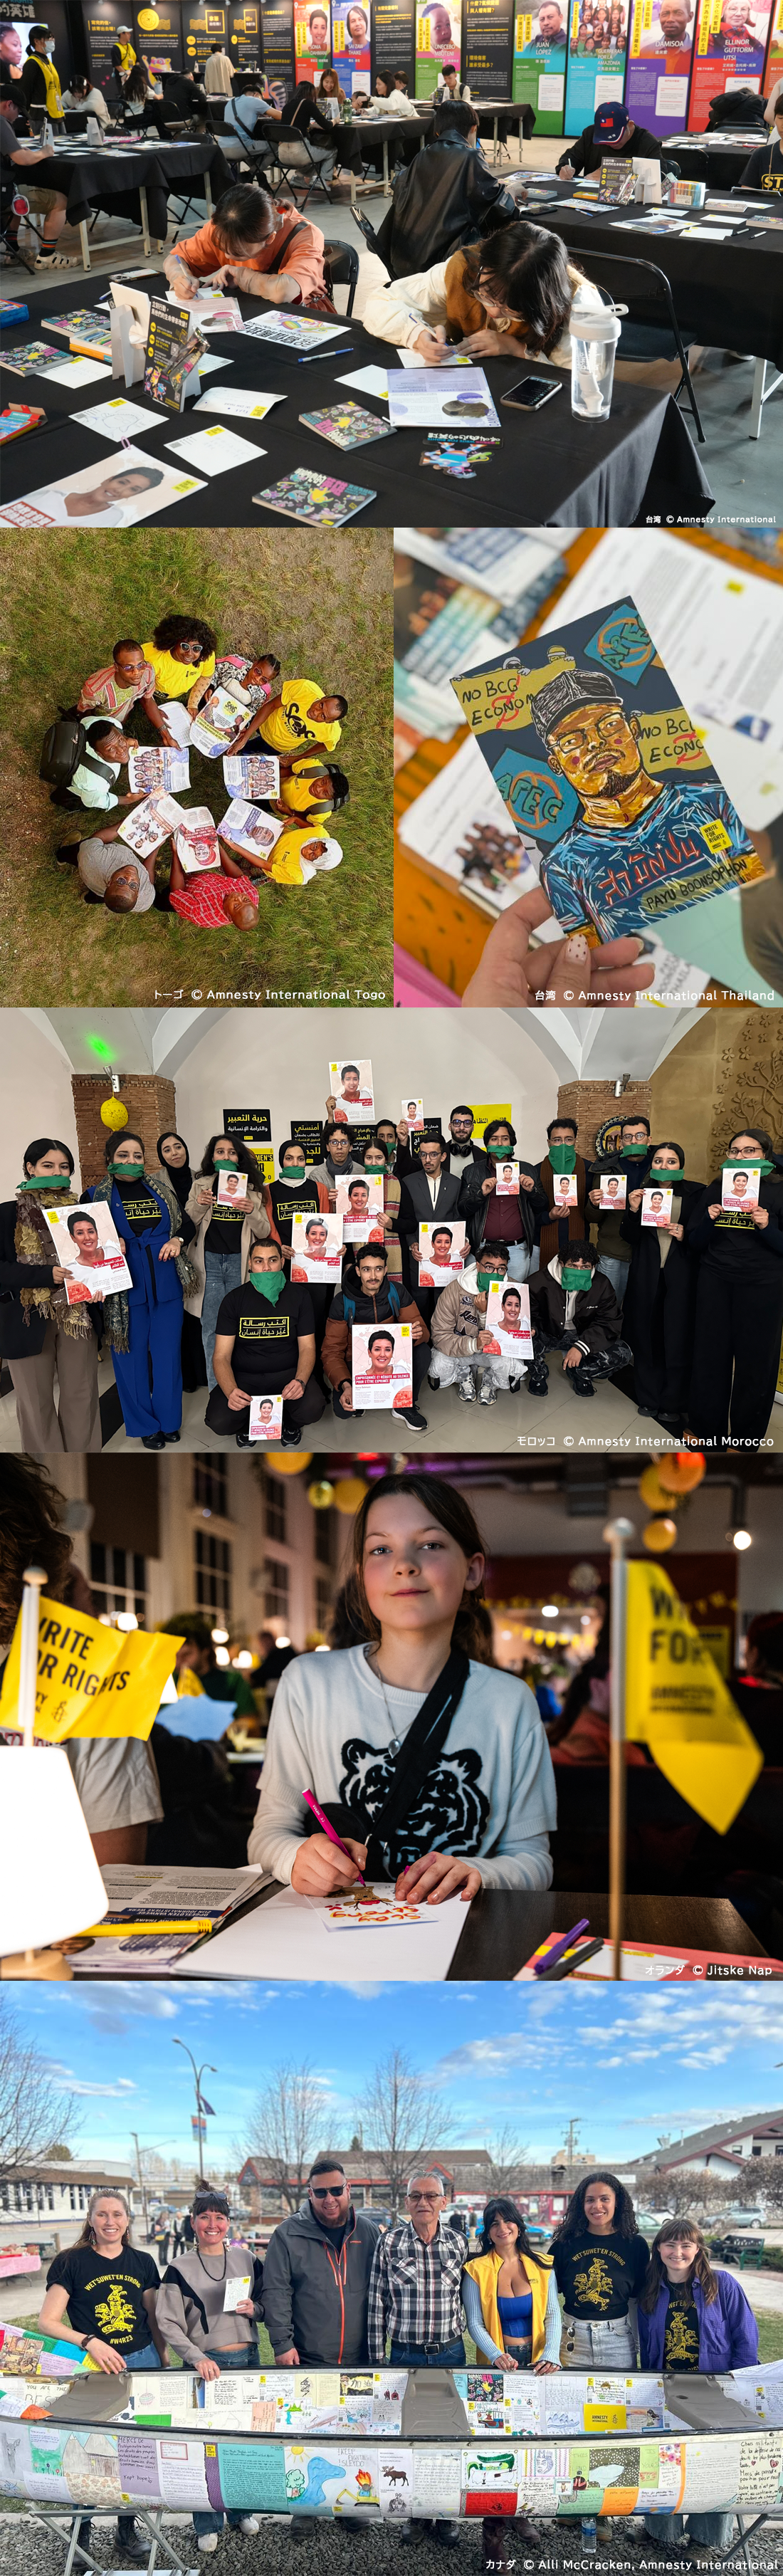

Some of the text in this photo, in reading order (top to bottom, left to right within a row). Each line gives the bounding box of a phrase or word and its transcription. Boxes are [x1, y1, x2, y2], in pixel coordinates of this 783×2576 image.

[463, 678, 518, 703] NO BCG
[641, 726, 661, 740] NO
[703, 823, 719, 833] WRITE
[708, 834, 725, 843] RIGHTS
[646, 859, 747, 911] PAYU BOONSOPHON
[227, 1114, 267, 1124] حرية التعبير
[294, 1123, 320, 1133] أمنستي
[572, 2248, 626, 2266] WET'SUWET'EN STRONG
[84, 2274, 141, 2291] WET'SUWET'EN STRONG
[110, 2335, 133, 2345] #W4R23
